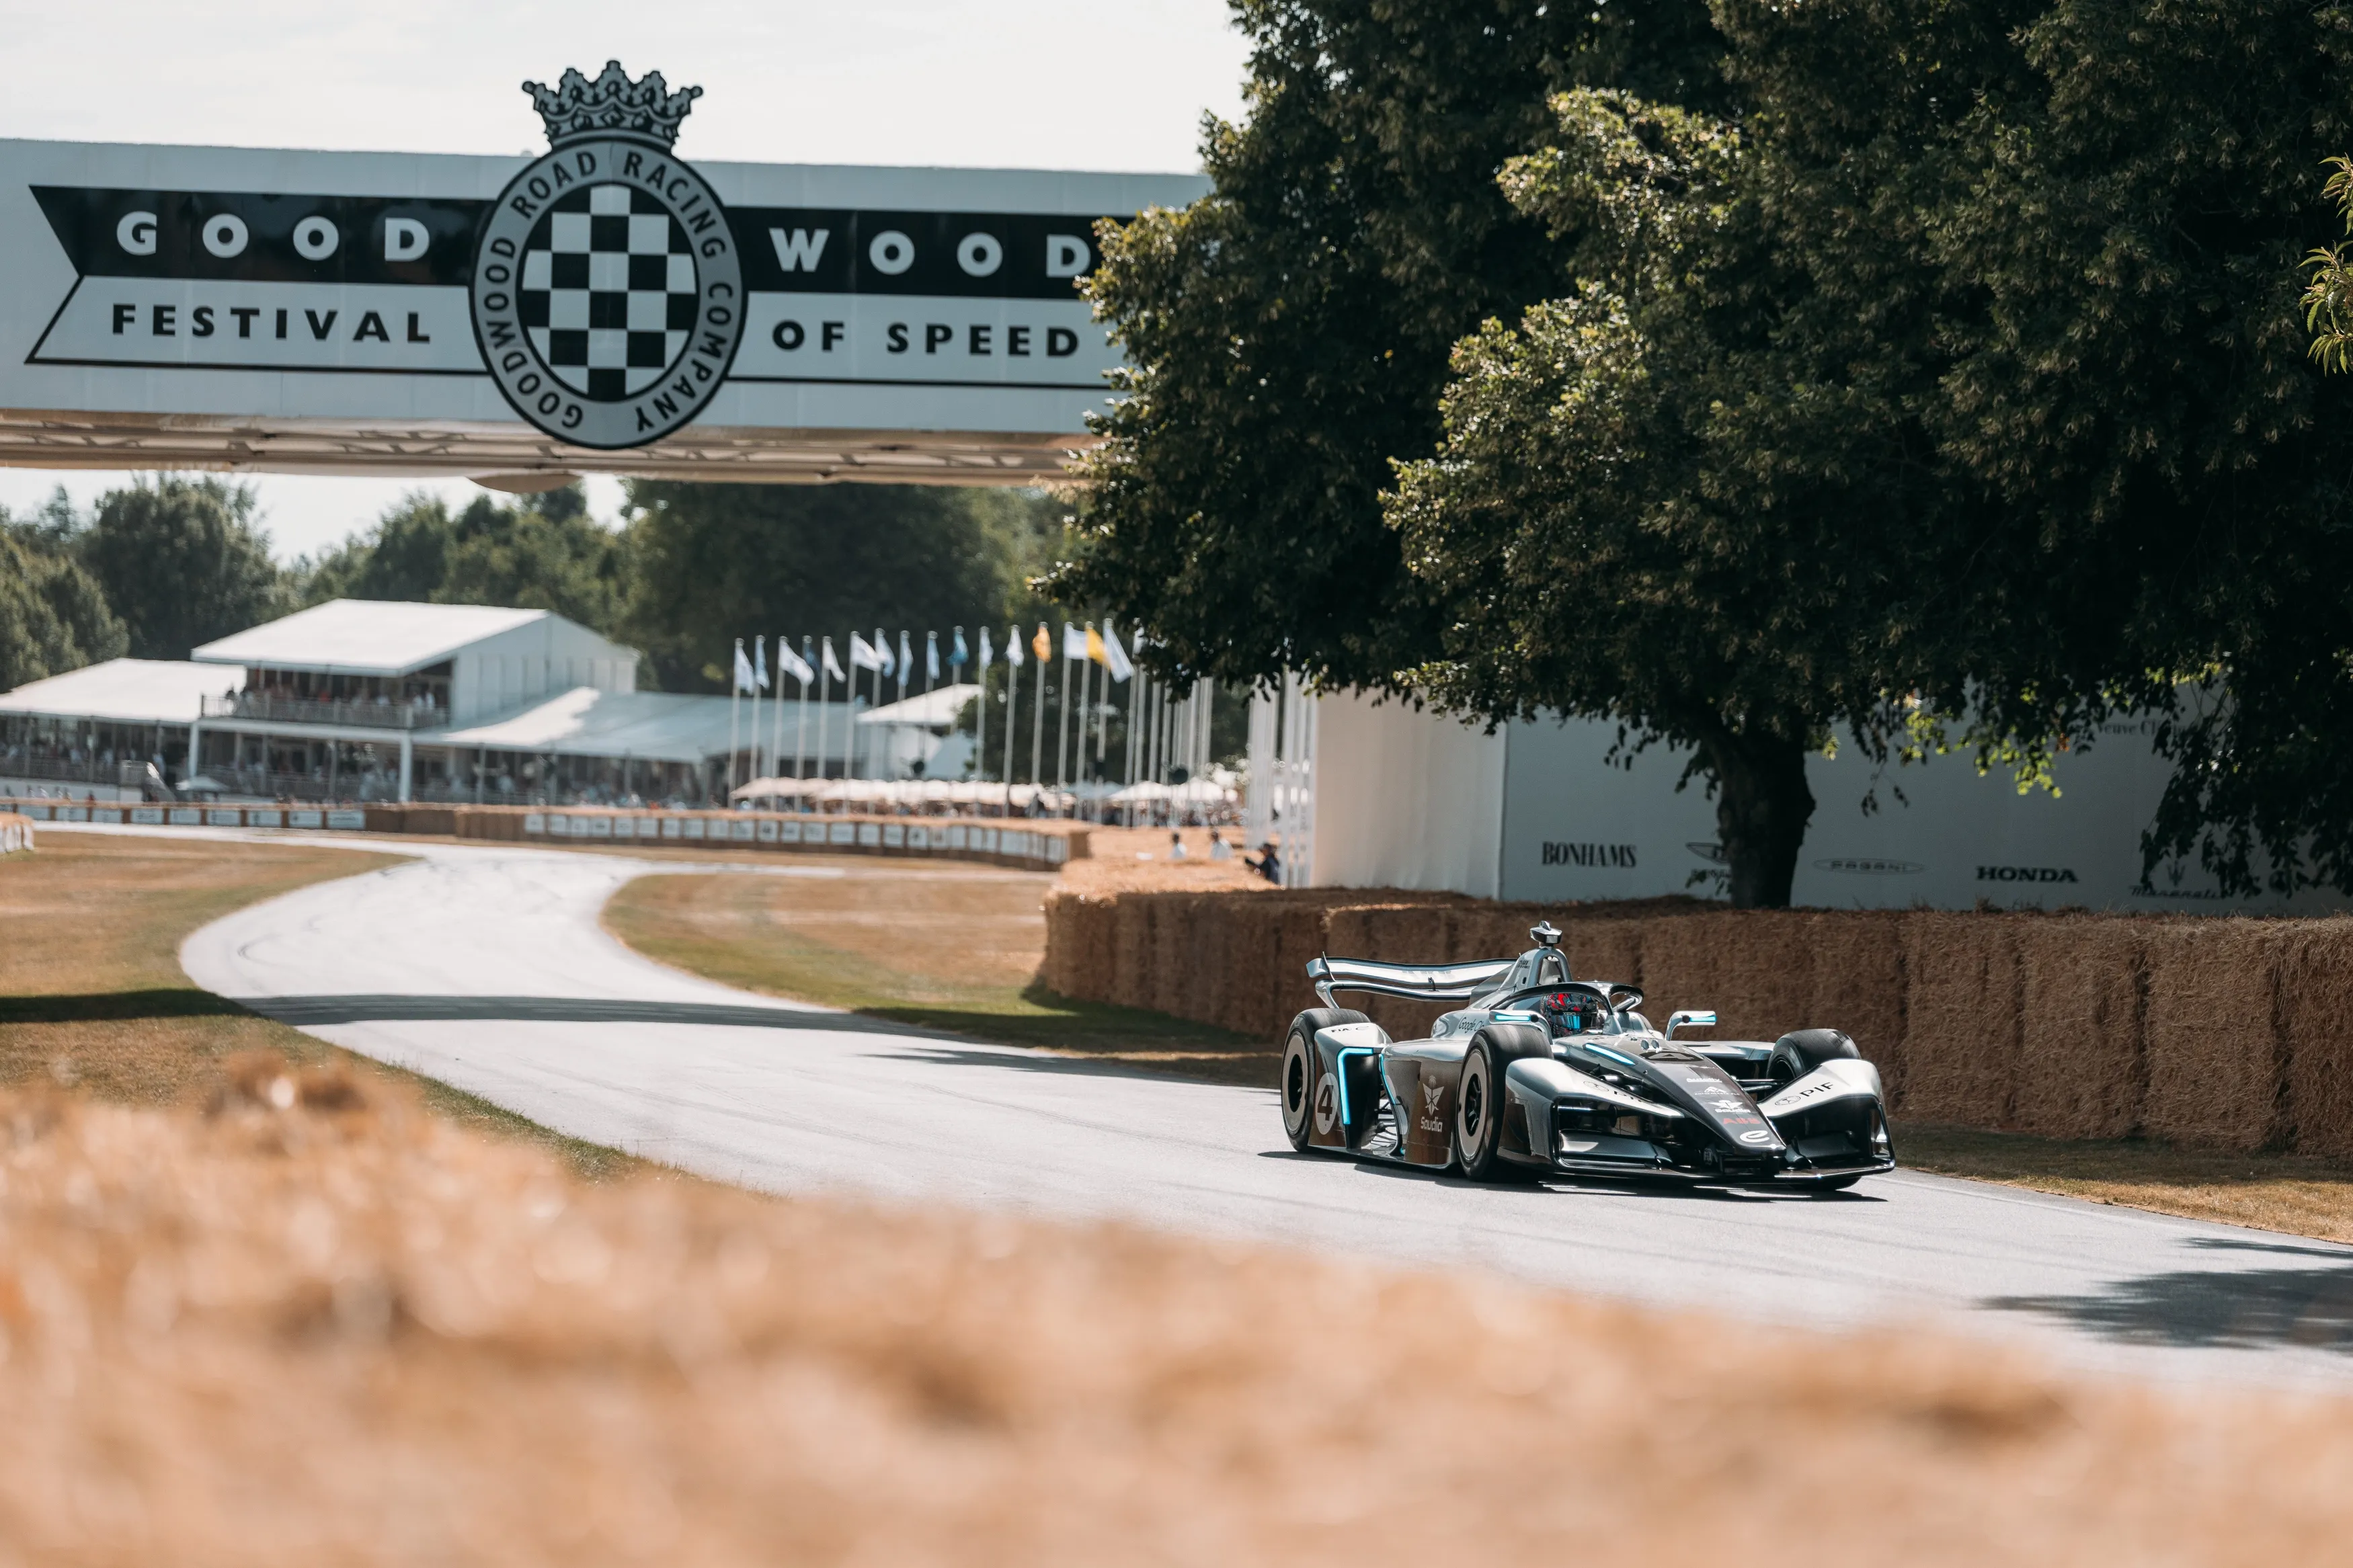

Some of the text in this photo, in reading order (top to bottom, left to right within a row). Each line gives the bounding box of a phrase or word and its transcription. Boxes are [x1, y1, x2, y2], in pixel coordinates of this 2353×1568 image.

[116, 211, 1091, 278] GOOD WOOD
[483, 151, 733, 432] GOODWOOD ROAD RACING COMPANY
[112, 303, 1079, 358] FESTIVAL OF SPEED
[1542, 841, 1637, 868] BONHAMS
[1977, 866, 2079, 883] HONDA
[1458, 1017, 1476, 1034] Google
[1317, 1084, 1334, 1121] 4
[1799, 1082, 1833, 1097] PIF
[1420, 1116, 1443, 1132] Saudia
